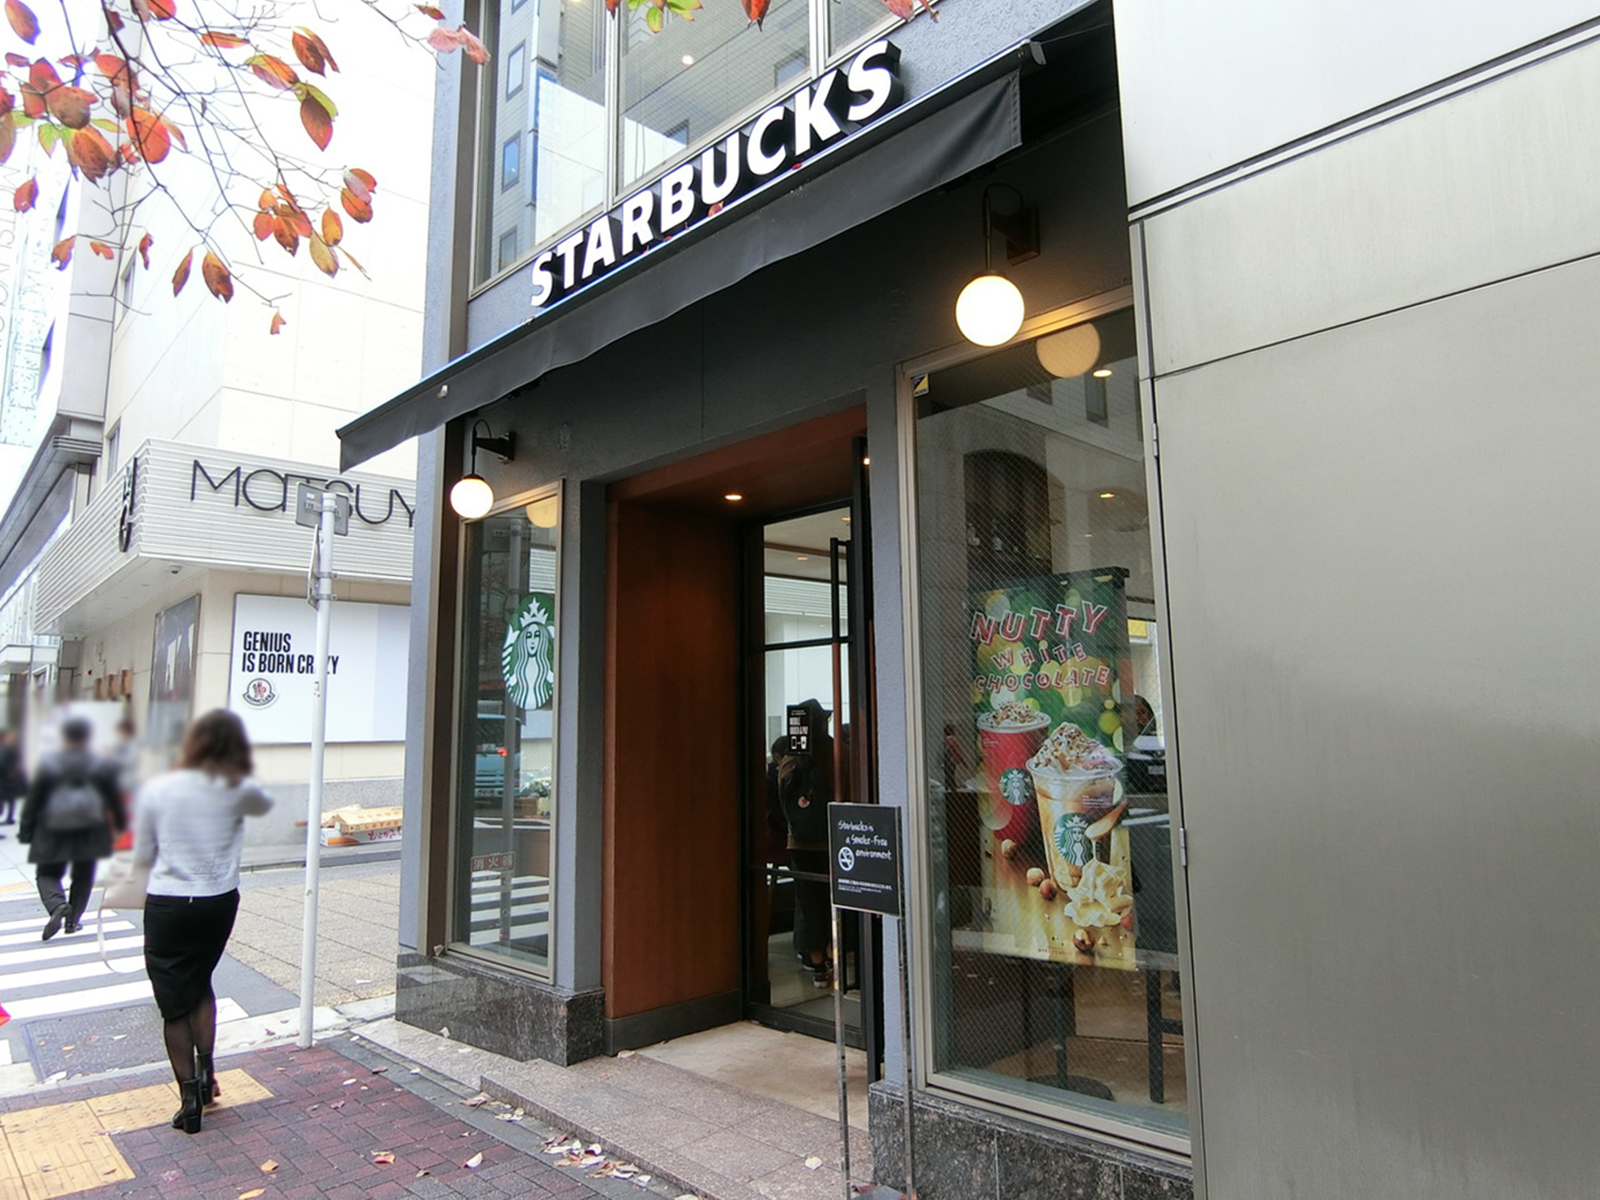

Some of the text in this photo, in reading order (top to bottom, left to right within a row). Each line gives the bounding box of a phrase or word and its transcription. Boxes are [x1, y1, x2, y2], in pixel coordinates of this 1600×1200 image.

[531, 39, 896, 306] STARBUCKS
[969, 600, 1108, 645] NUTTY
[243, 631, 291, 652] GENIUS
[242, 652, 339, 675] IS BORN CRY
[991, 642, 1087, 670] WHITE
[974, 665, 1110, 694] CHOCOLATE
